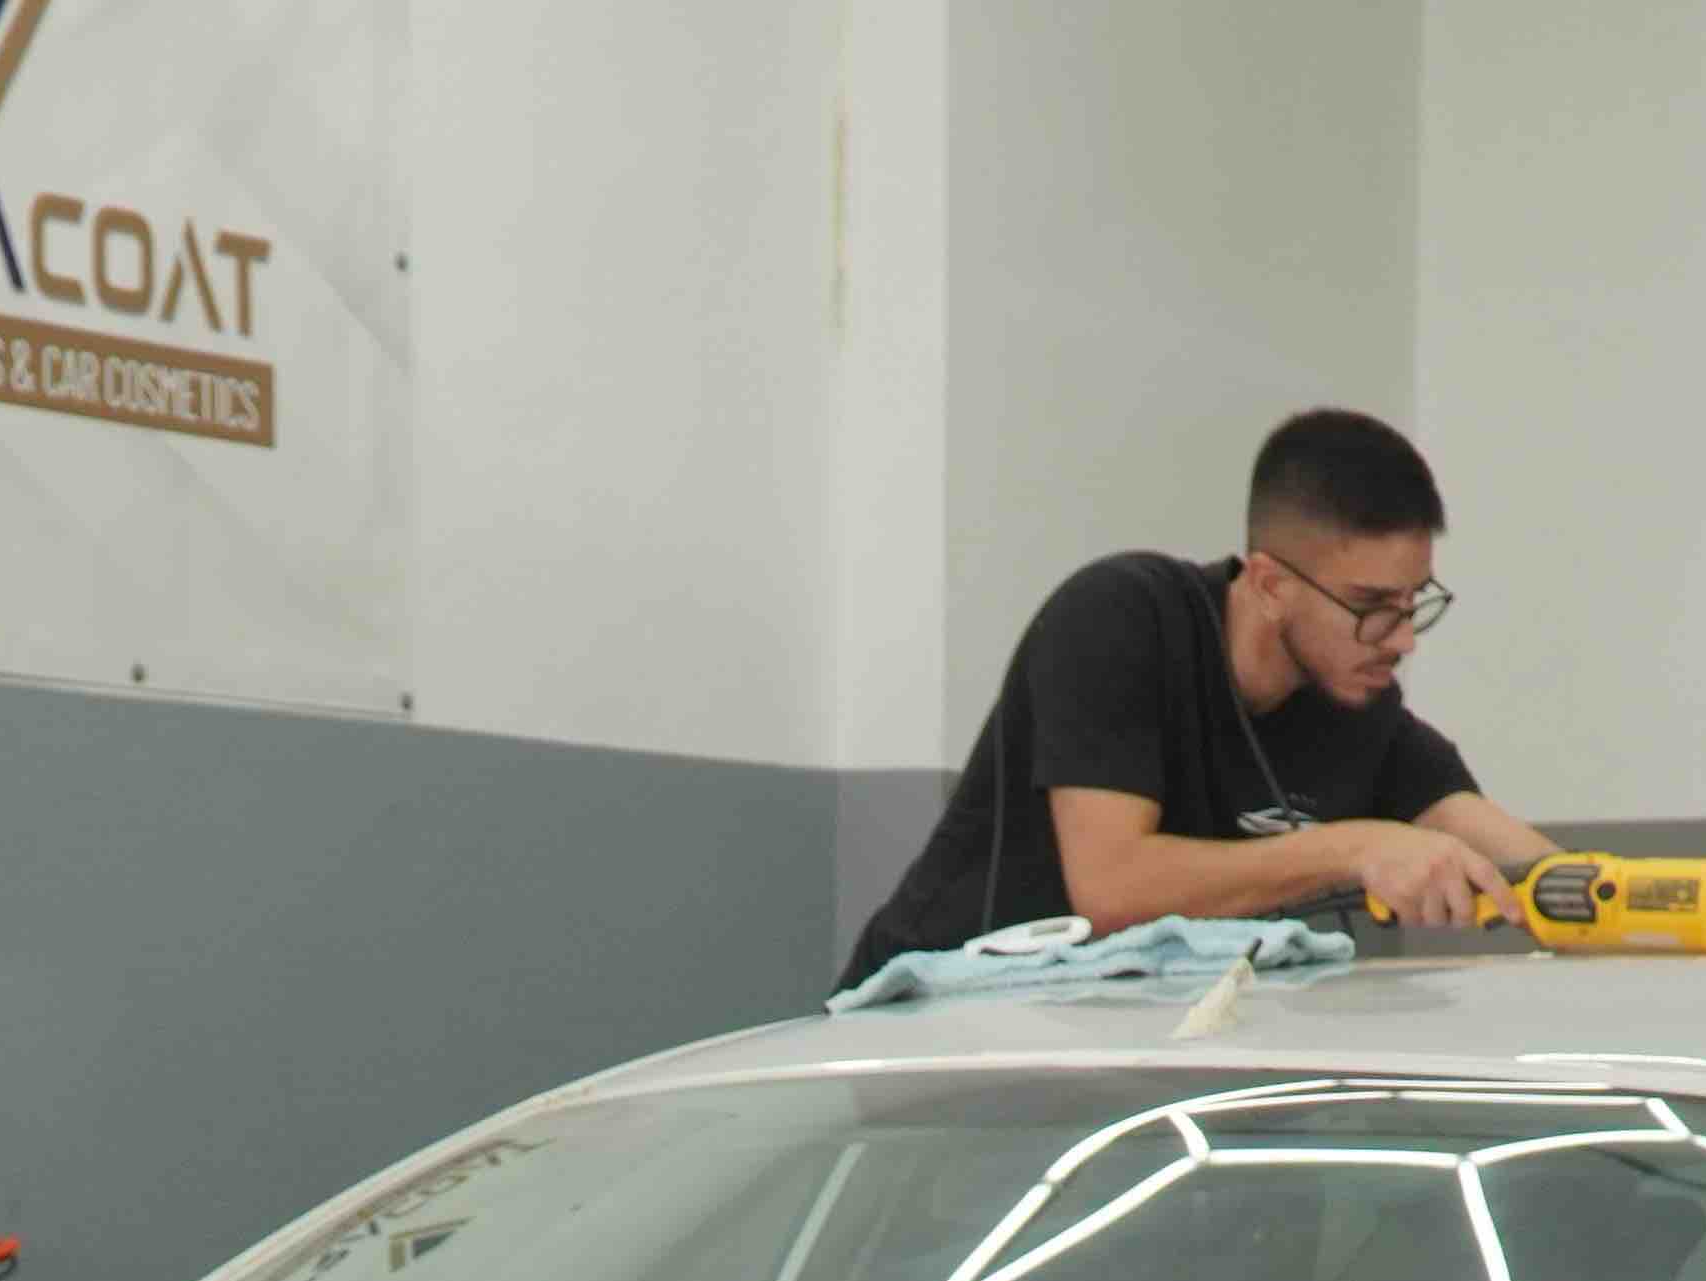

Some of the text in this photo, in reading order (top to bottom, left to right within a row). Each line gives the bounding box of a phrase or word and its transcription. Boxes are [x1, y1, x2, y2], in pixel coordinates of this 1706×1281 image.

[9, 339, 37, 392] &
[40, 342, 102, 405] CAR
[103, 357, 261, 432] COSMETICS
